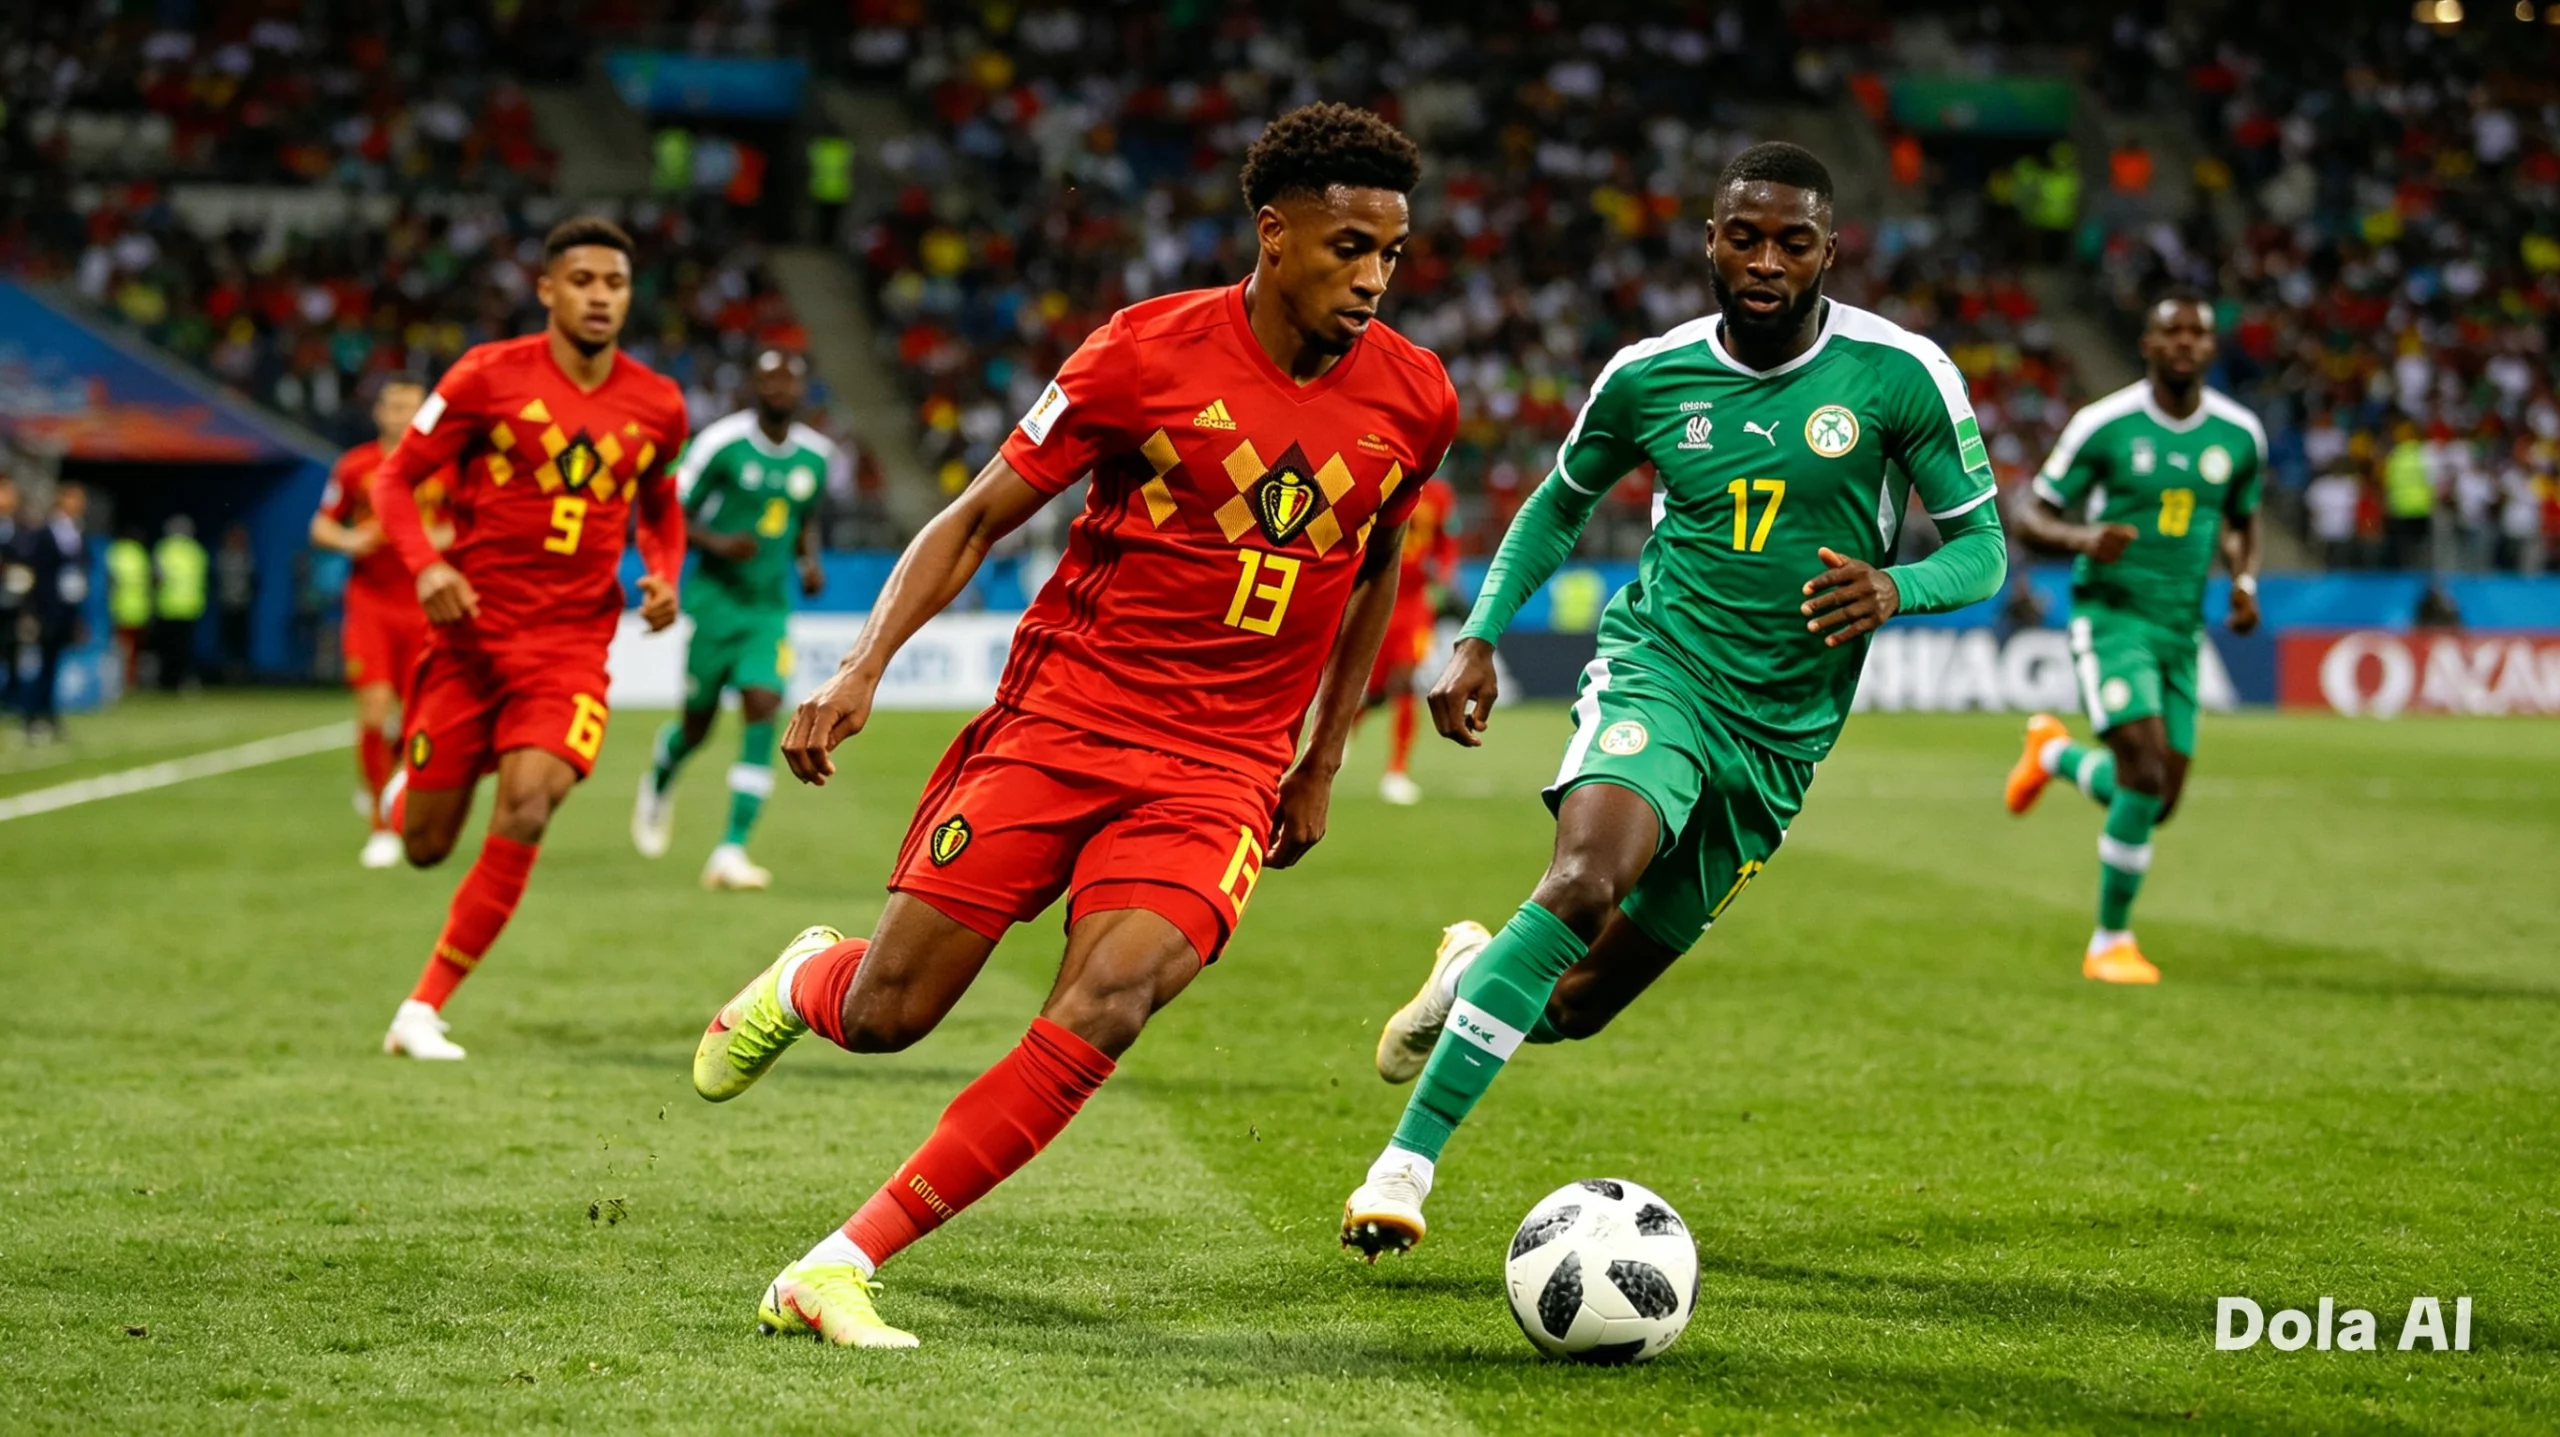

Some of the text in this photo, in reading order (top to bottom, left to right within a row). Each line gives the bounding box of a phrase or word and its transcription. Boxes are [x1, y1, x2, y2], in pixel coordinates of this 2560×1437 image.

[1728, 478, 1786, 552] 17
[1223, 548, 1301, 637] 13
[1218, 824, 1263, 920] 13
